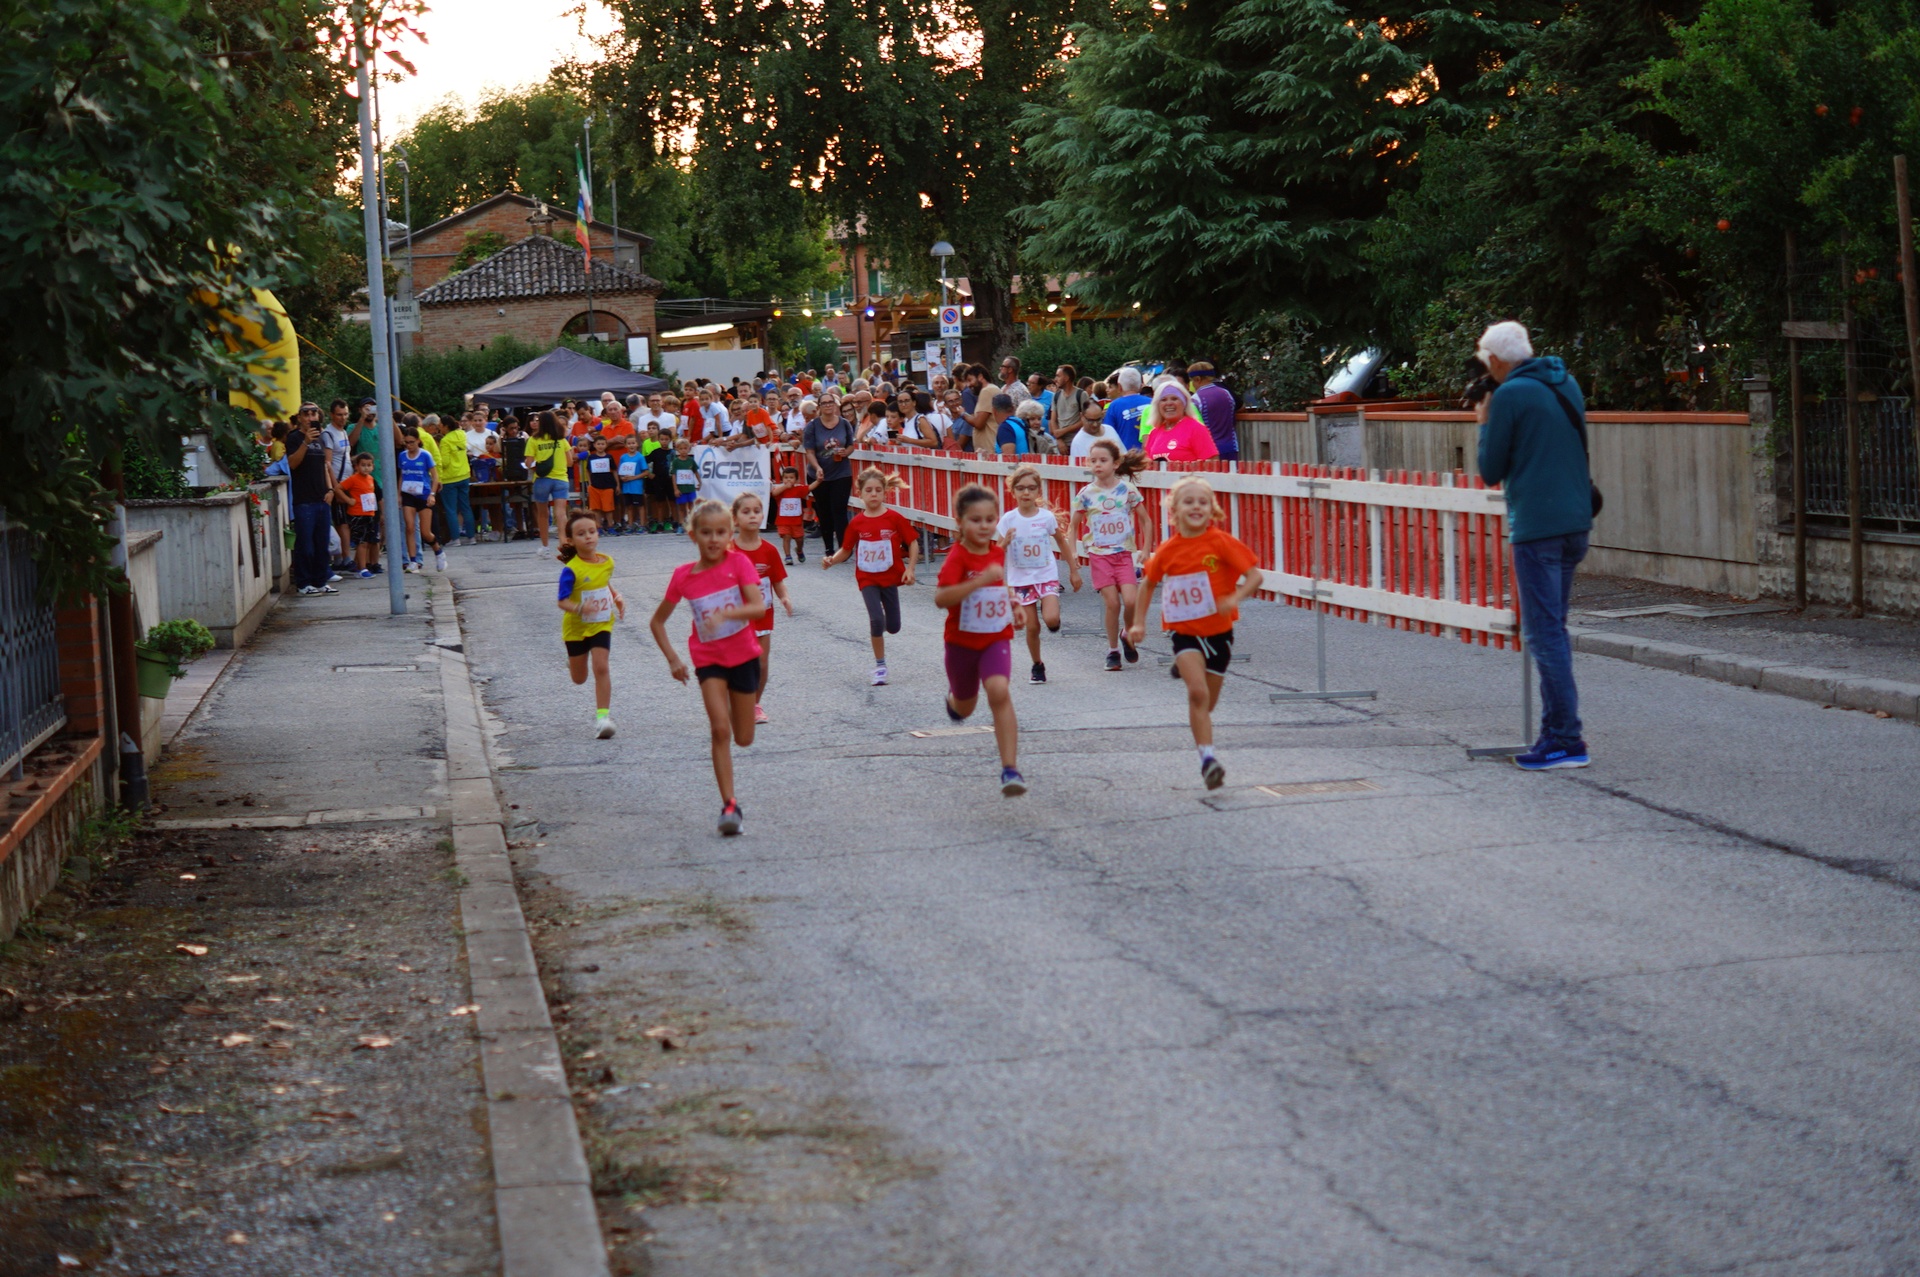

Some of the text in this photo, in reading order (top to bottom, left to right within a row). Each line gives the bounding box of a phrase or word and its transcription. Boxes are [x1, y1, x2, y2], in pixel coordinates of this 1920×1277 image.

[702, 461, 763, 479] SICREA
[784, 503, 798, 511] 397
[1099, 521, 1124, 536] 409
[863, 550, 886, 563] 274
[1023, 544, 1041, 558] 50
[1169, 587, 1203, 608] 419
[974, 600, 1007, 619] 133
